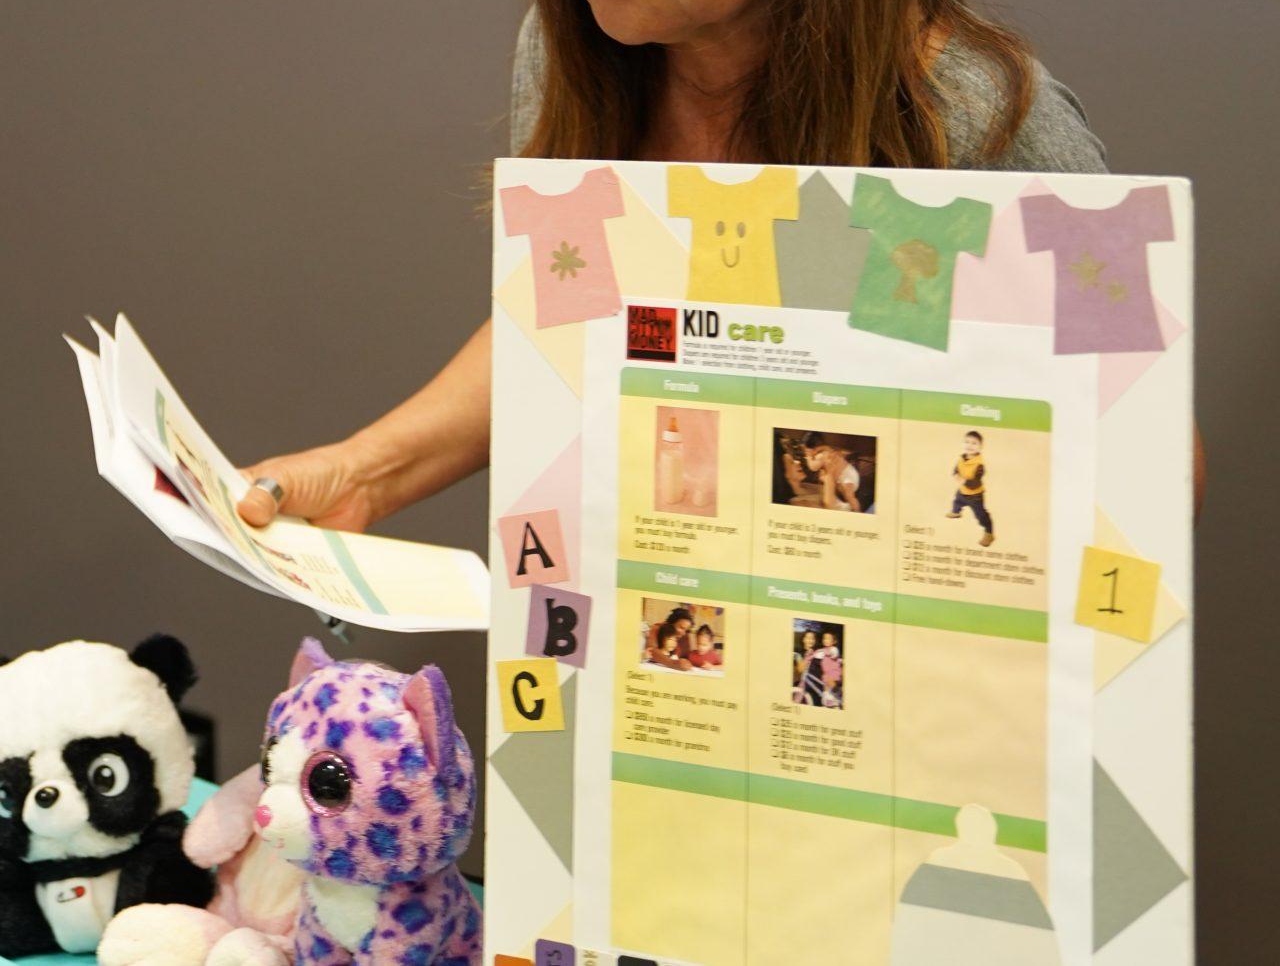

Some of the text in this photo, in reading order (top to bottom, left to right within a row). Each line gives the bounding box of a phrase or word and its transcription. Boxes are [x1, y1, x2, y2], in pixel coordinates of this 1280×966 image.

[684, 309, 784, 343] KID care
[664, 380, 699, 393] Formula
[812, 391, 848, 405] Diapers
[960, 403, 1001, 421] Clothing
[516, 522, 555, 576] A
[656, 572, 699, 588] Child care
[768, 586, 808, 602] Presents,
[843, 596, 861, 608] and
[543, 598, 578, 657] B
[512, 671, 544, 720] C
